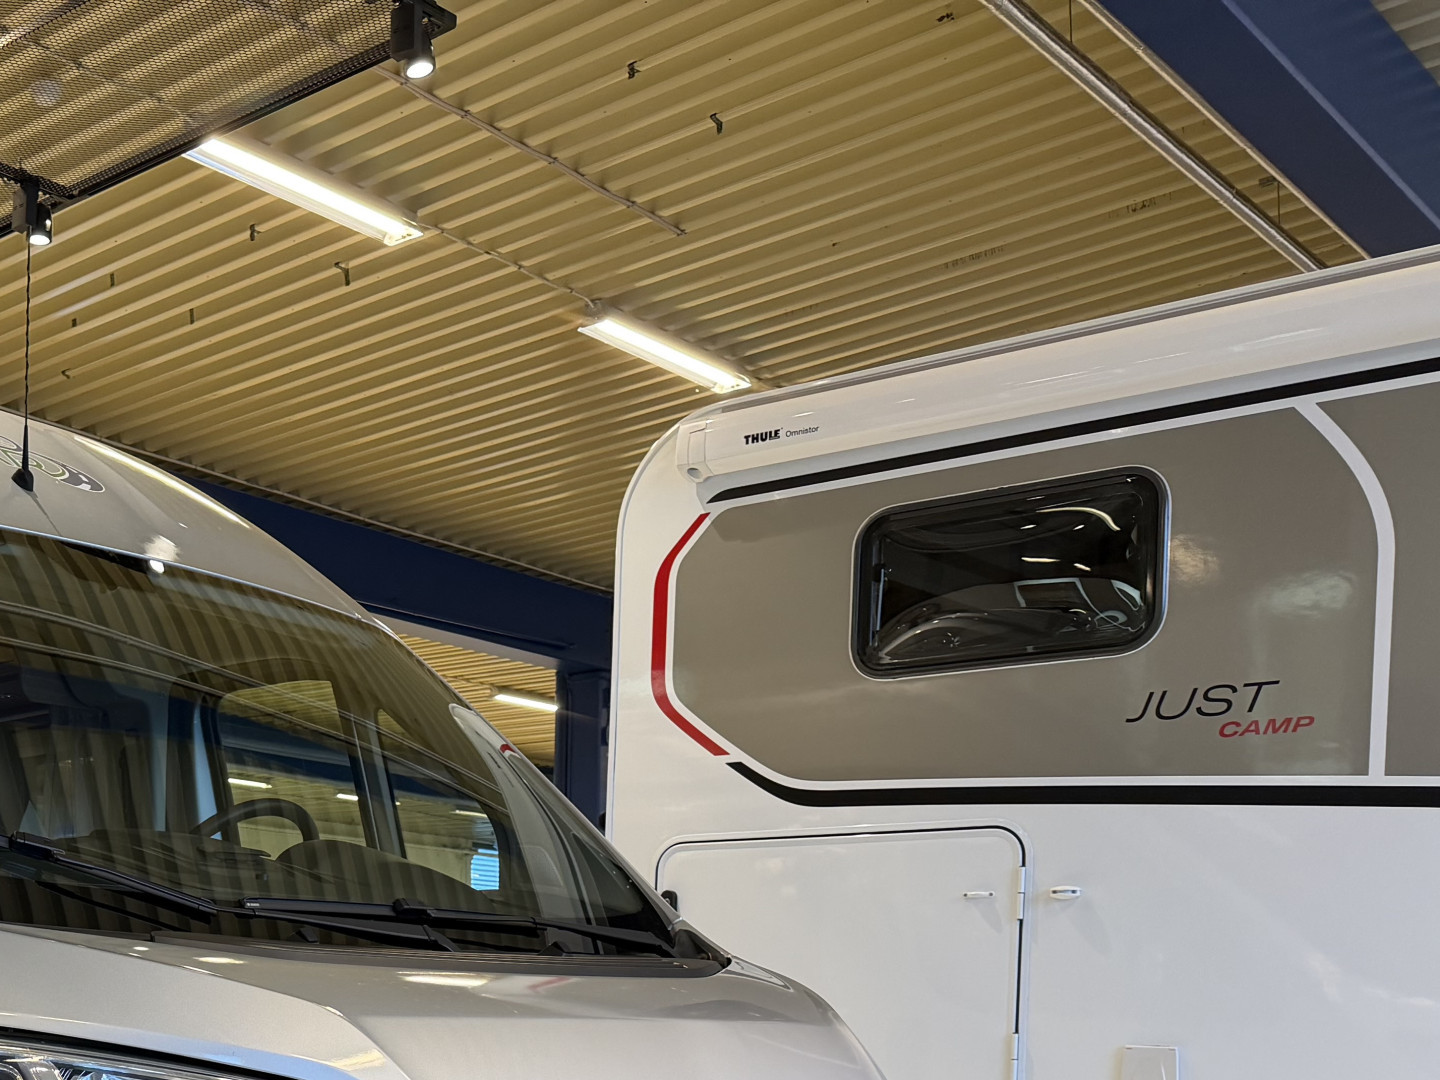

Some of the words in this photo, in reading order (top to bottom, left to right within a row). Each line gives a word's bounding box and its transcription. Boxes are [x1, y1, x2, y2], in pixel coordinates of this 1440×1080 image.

[744, 428, 781, 445] THULE
[785, 426, 819, 438] Omnistor
[1125, 680, 1281, 723] JUST
[1218, 715, 1315, 738] CAMP
